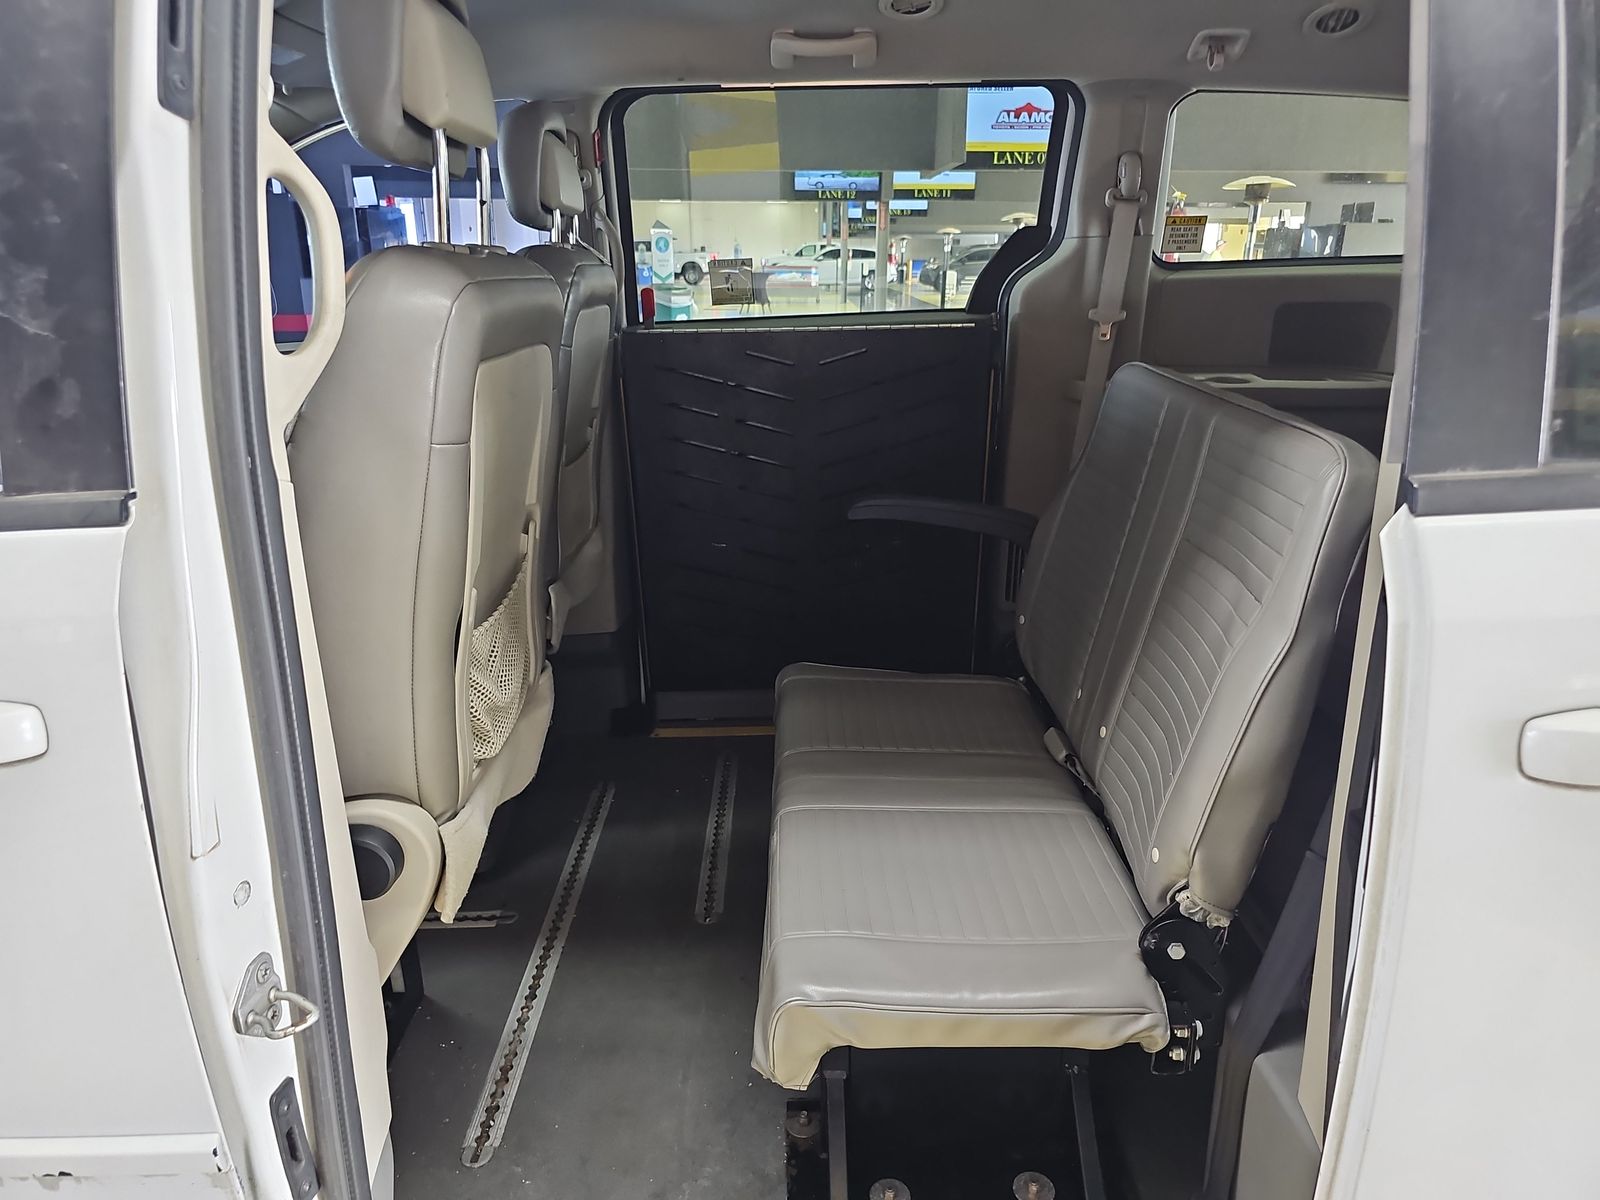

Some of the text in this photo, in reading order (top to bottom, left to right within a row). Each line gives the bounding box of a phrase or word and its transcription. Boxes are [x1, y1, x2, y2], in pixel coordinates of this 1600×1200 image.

[993, 151, 1034, 165] LANE
[818, 190, 856, 199] LANE 12
[914, 189, 951, 198] LANE 11
